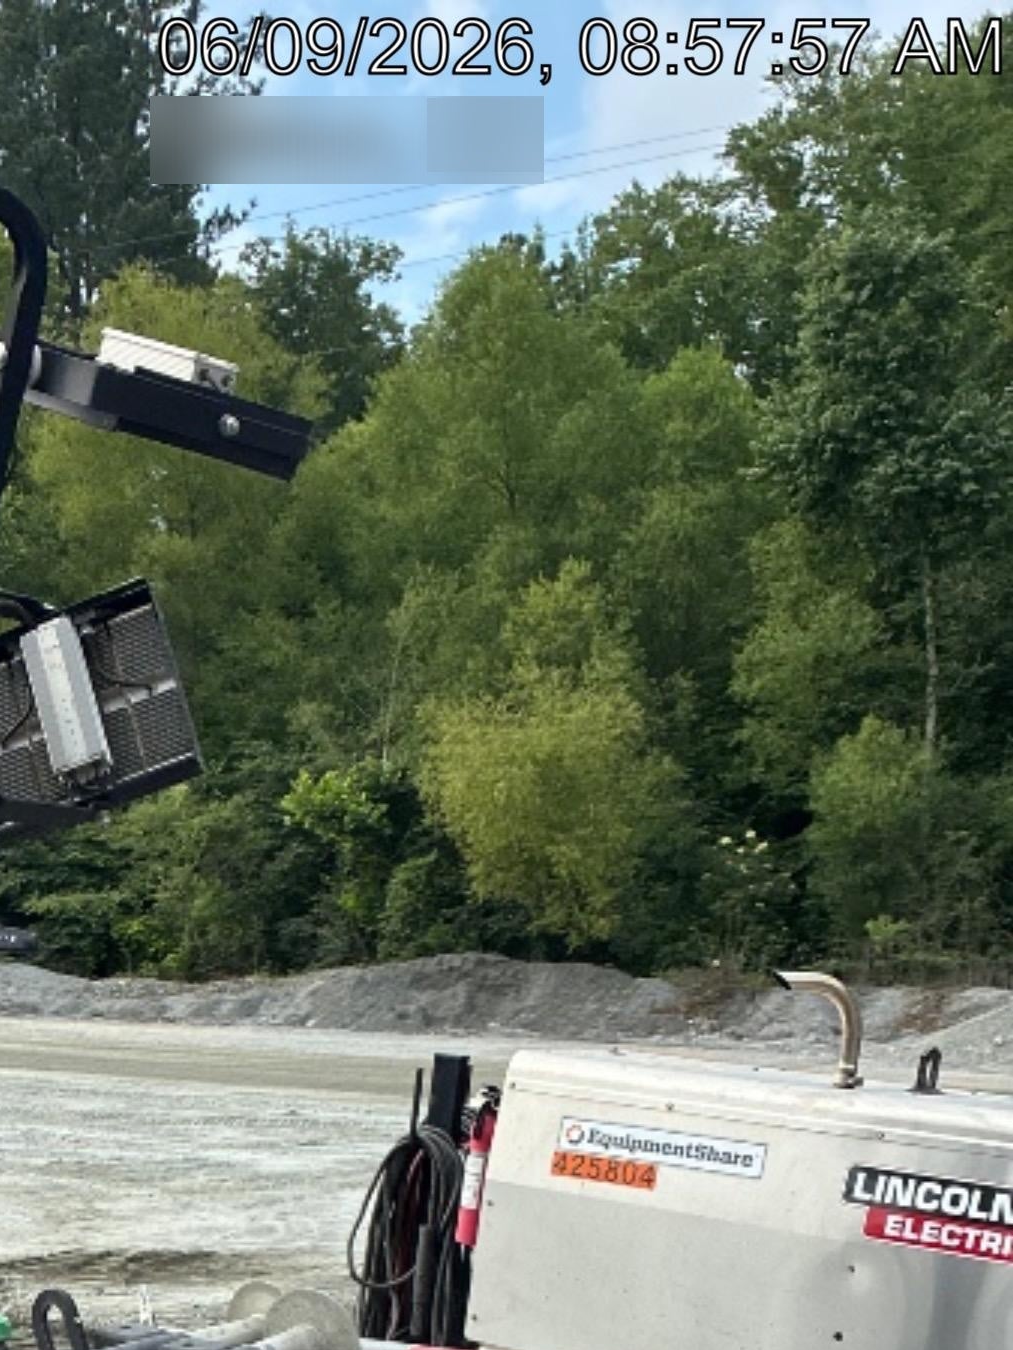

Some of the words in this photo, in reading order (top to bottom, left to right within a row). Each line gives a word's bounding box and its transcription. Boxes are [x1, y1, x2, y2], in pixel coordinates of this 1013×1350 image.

[587, 1127, 754, 1169] EquipmentShare
[553, 1152, 656, 1187] 425804
[851, 1171, 1013, 1225] LINCOLN
[883, 1214, 1013, 1256] ELECTRI
